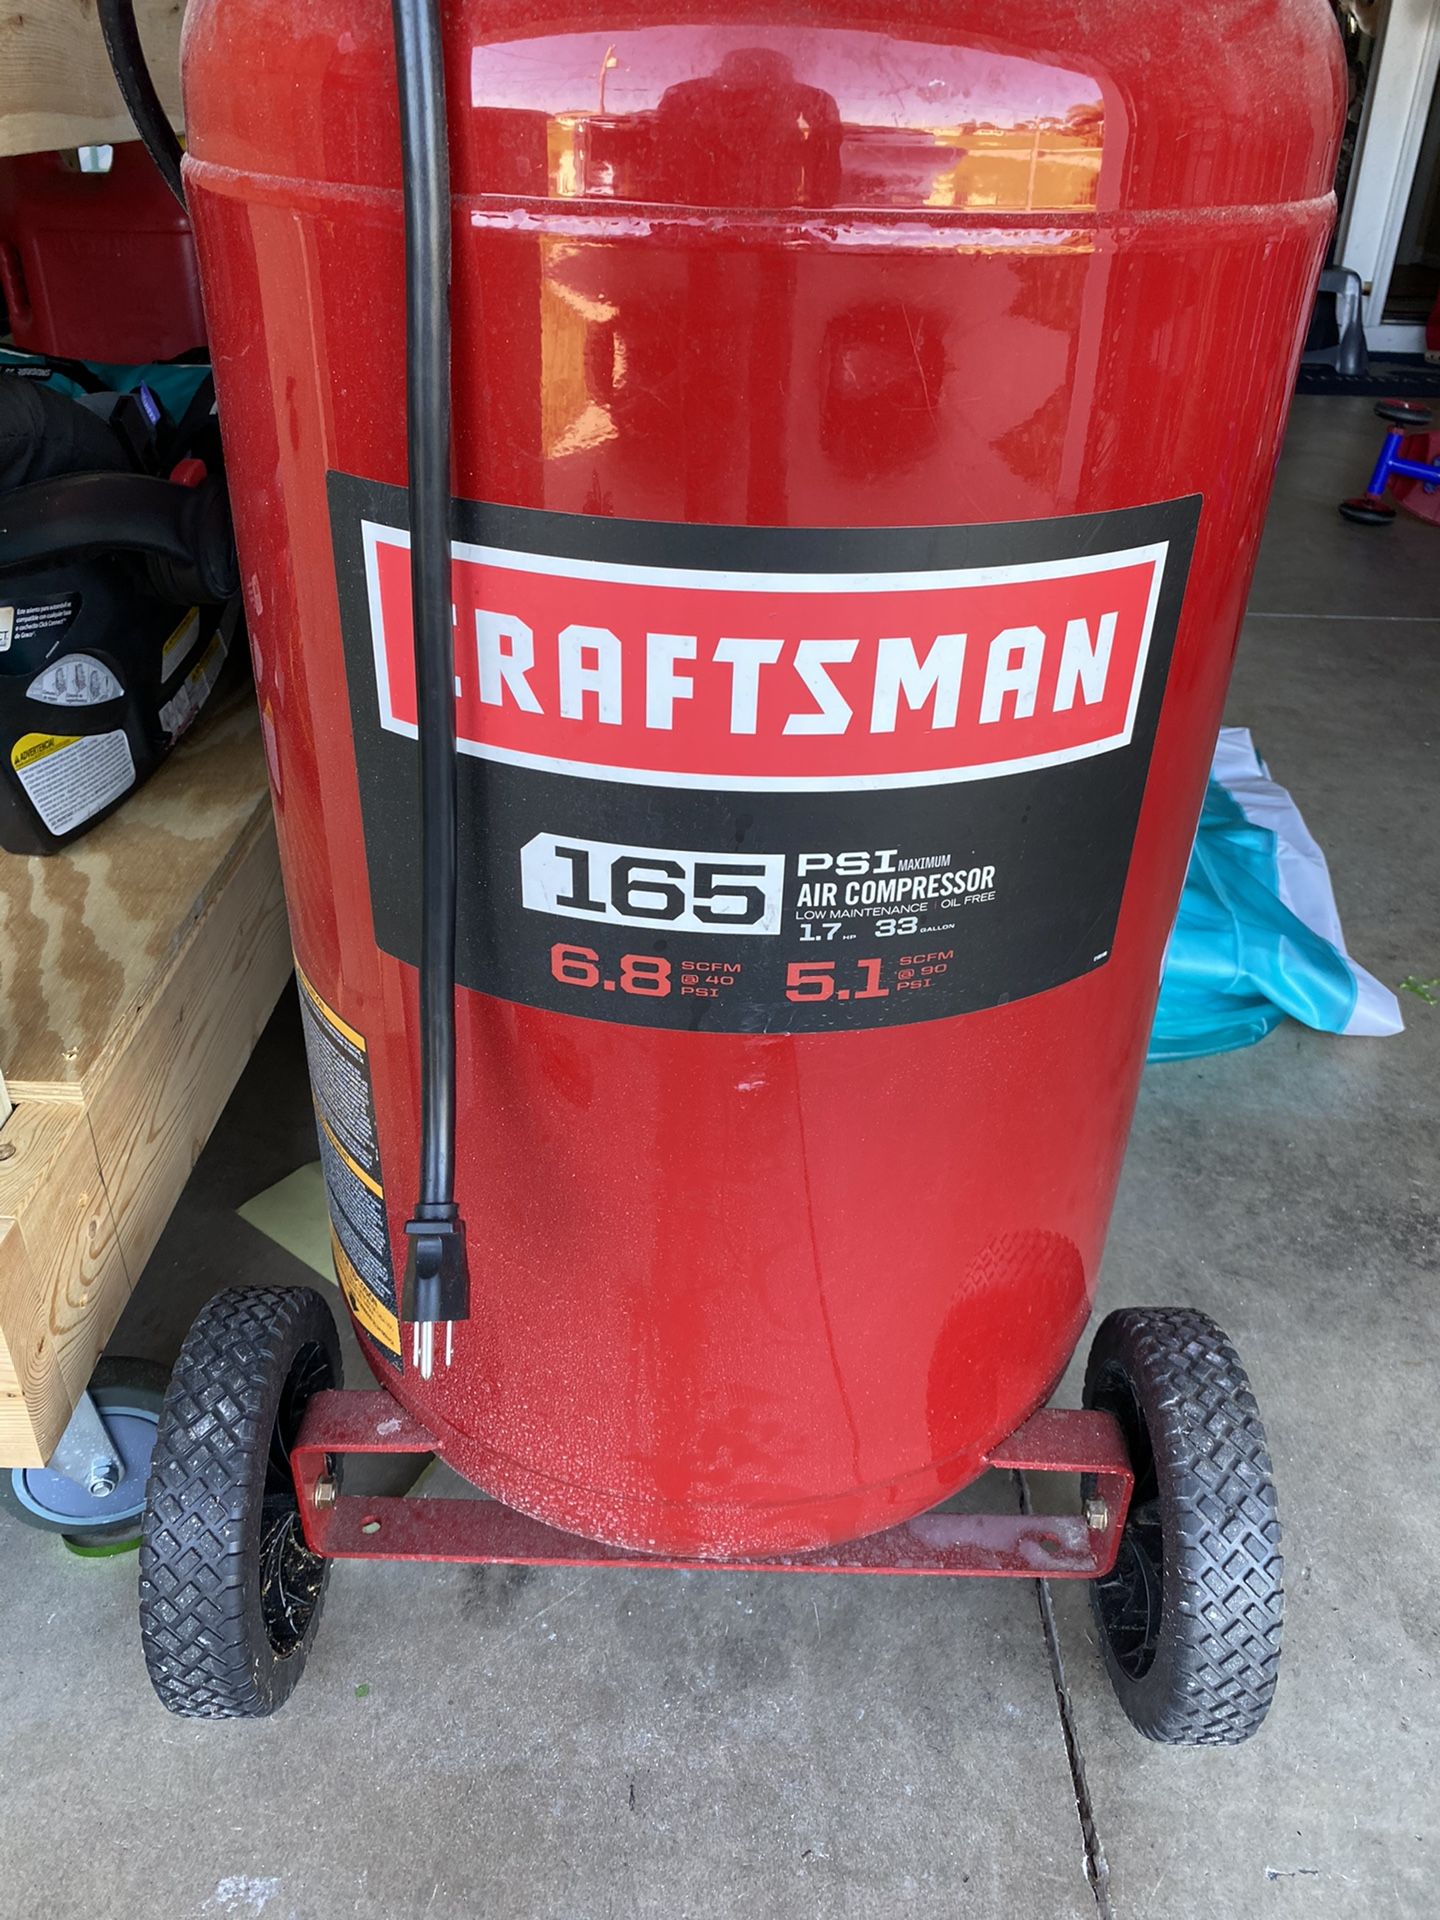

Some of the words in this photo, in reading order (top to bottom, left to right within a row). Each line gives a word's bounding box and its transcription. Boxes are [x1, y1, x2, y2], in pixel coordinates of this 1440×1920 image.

[452, 603, 1119, 735] RAFTSMAN
[797, 849, 898, 877] PSI
[897, 854, 951, 872] MAXIMUM
[555, 845, 766, 925] 165
[796, 883, 838, 907] AIR
[845, 865, 996, 906] COMPRESSOR
[795, 910, 827, 920] LOW
[829, 902, 928, 919] MAINTENANCE
[940, 898, 961, 909] OIL
[964, 891, 996, 905] FREE
[799, 922, 842, 942] 1.7
[874, 916, 919, 938] 33
[919, 923, 955, 934] GALLON
[681, 961, 742, 973] SCFM
[899, 950, 954, 966] SCFM
[551, 943, 671, 997] 6.8
[681, 974, 699, 985] @
[705, 975, 734, 985] 40
[785, 958, 890, 1002] 5.1
[896, 969, 915, 981] @
[920, 963, 947, 977] 90
[681, 987, 719, 997] PSI
[896, 979, 932, 991] PSI
